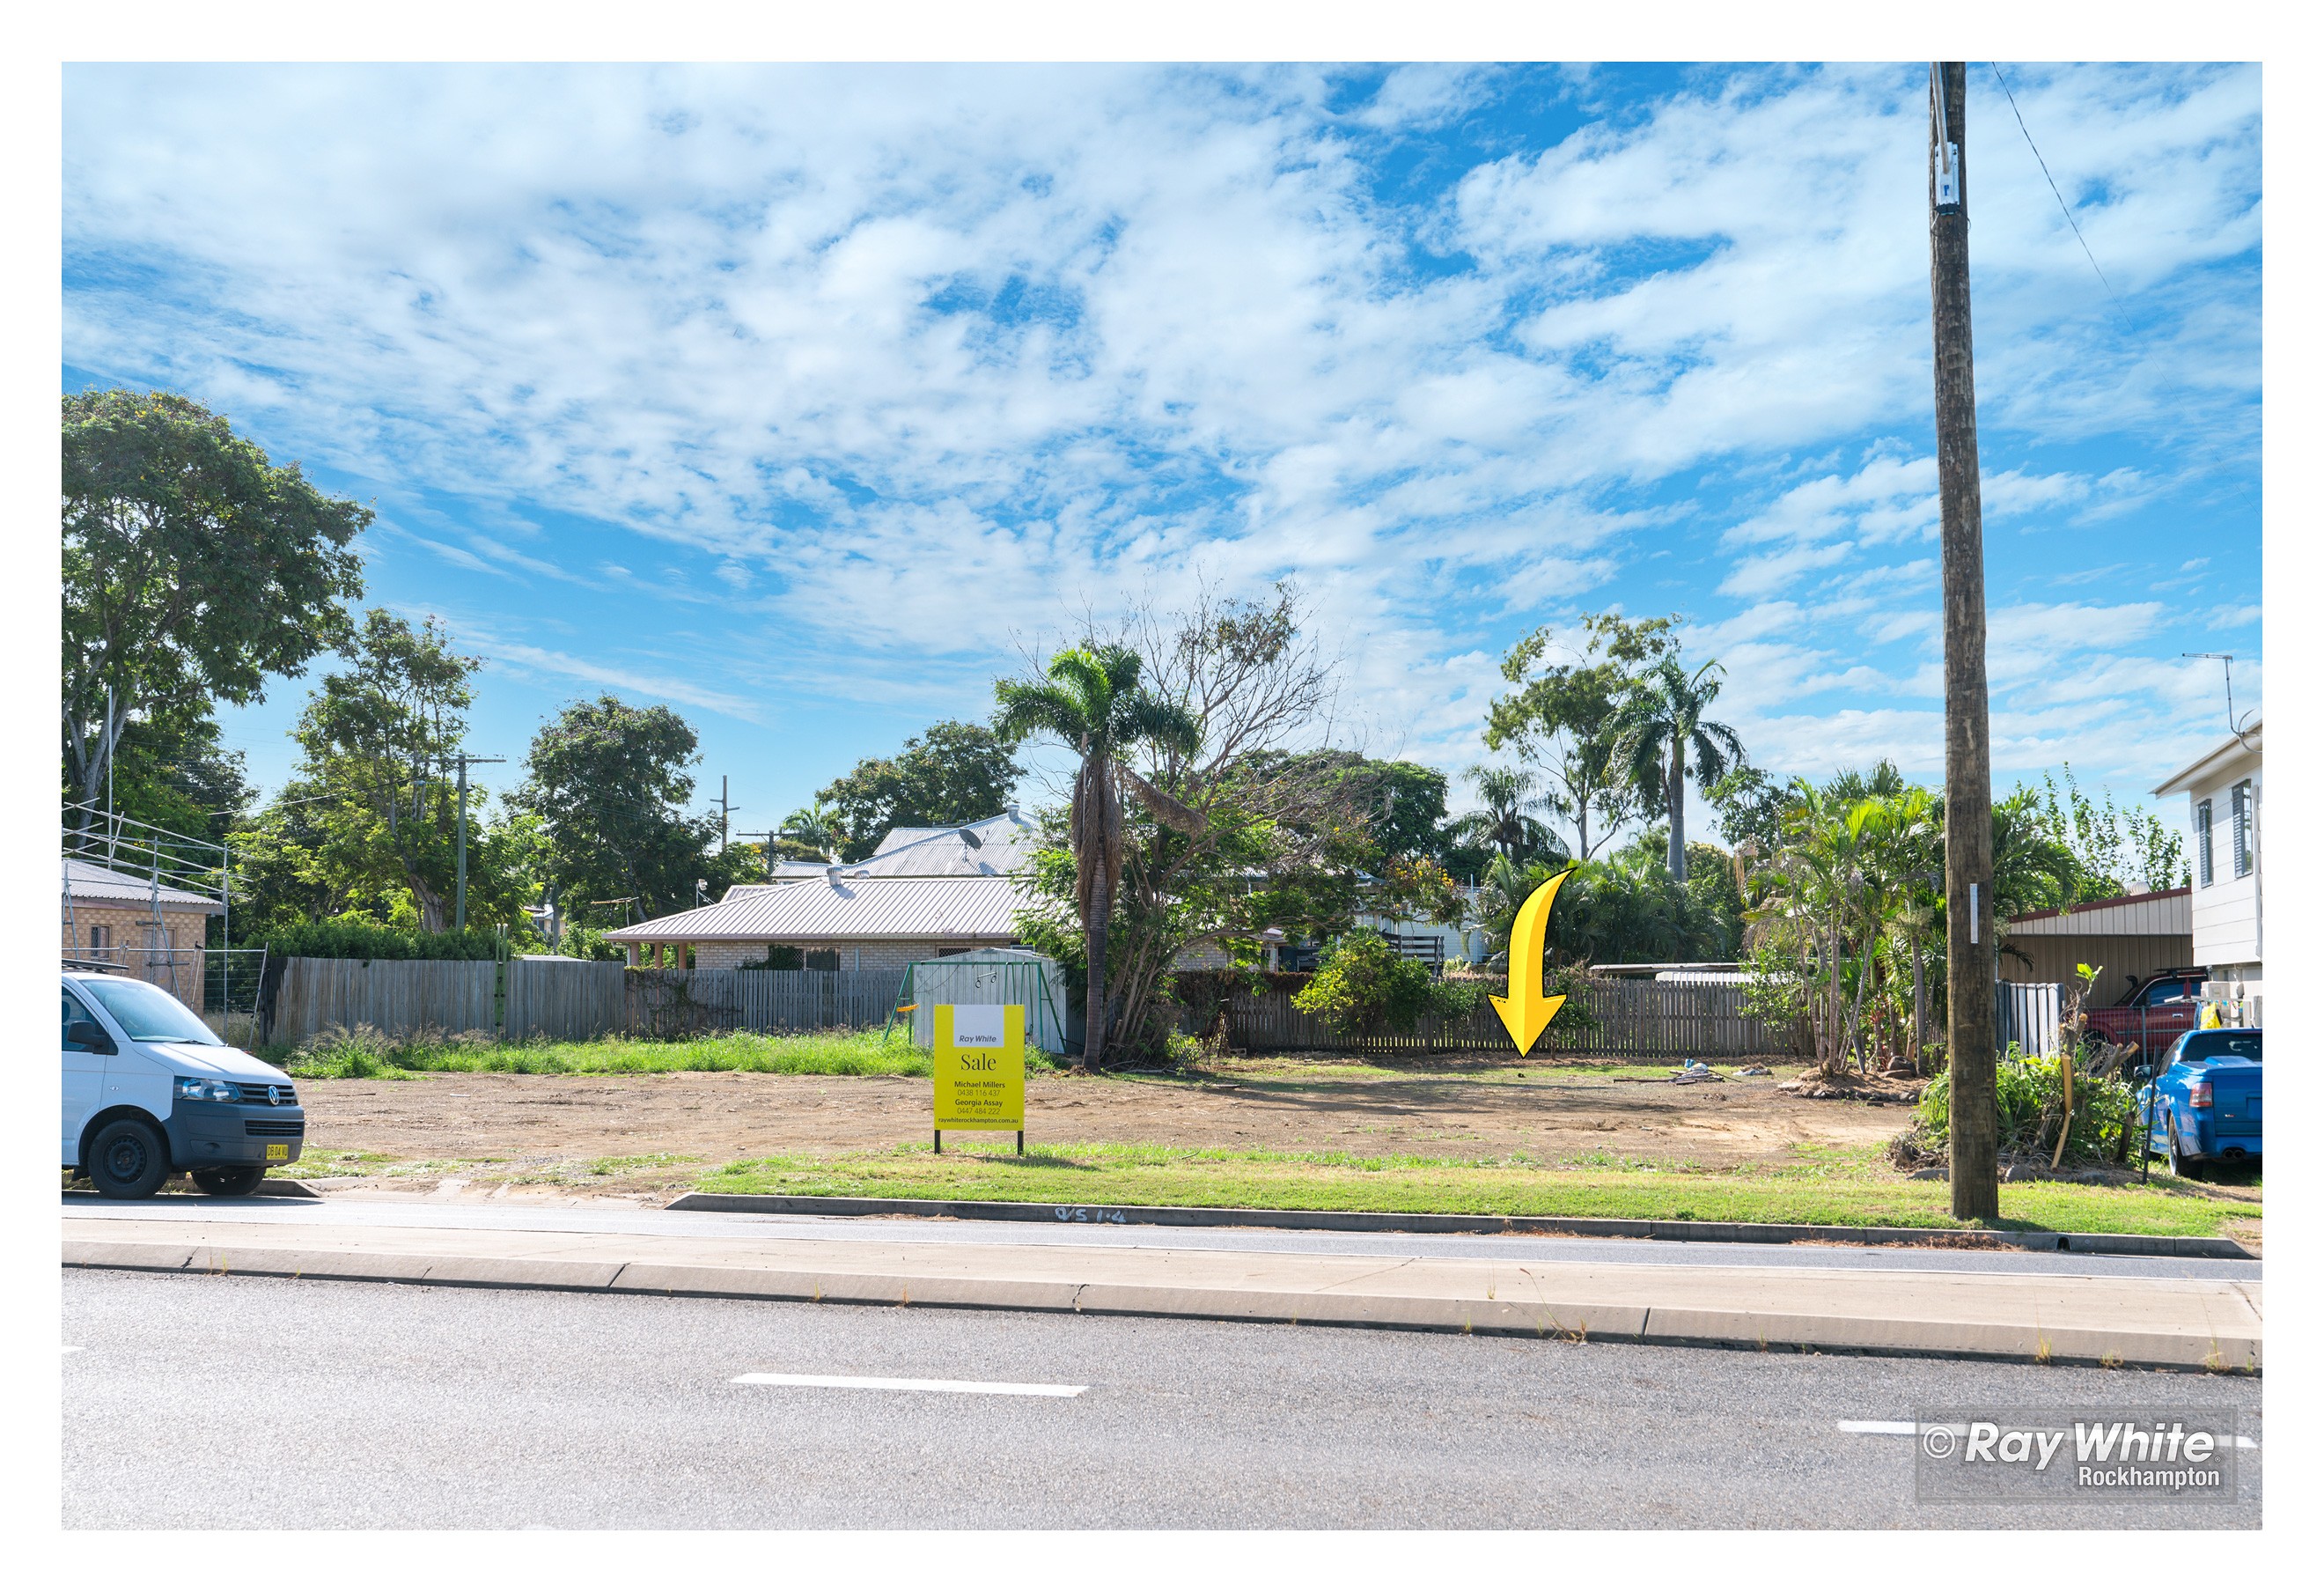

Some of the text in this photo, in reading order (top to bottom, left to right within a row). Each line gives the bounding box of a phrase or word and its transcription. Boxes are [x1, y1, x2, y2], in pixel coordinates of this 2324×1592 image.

[959, 1035, 974, 1043] Ray
[960, 1053, 997, 1071] Sale
[983, 1099, 1004, 1108] Assay
